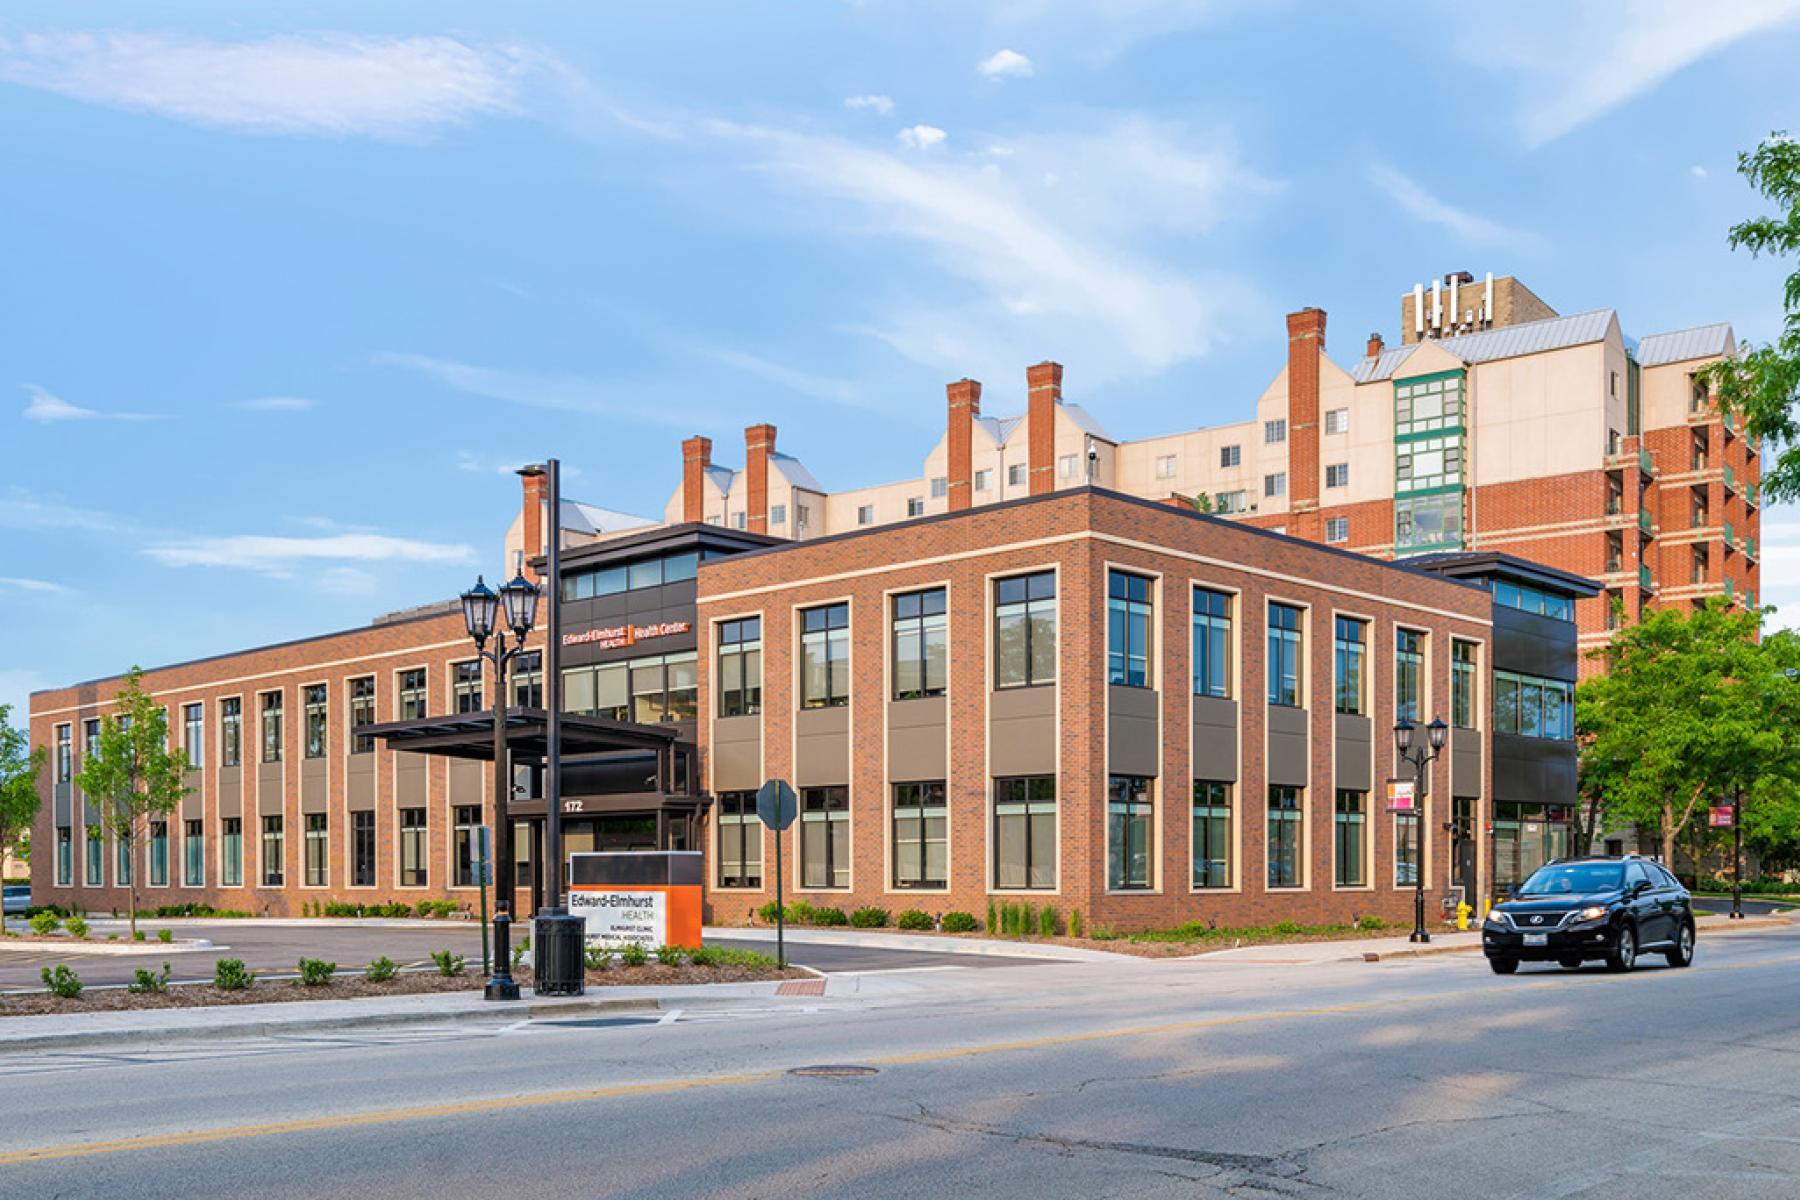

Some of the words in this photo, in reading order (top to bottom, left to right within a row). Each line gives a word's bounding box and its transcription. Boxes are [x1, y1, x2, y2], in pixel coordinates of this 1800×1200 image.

[564, 800, 584, 812] 172
[571, 894, 654, 908] Edward-Elmhurst
[621, 910, 655, 921] HEALTH
